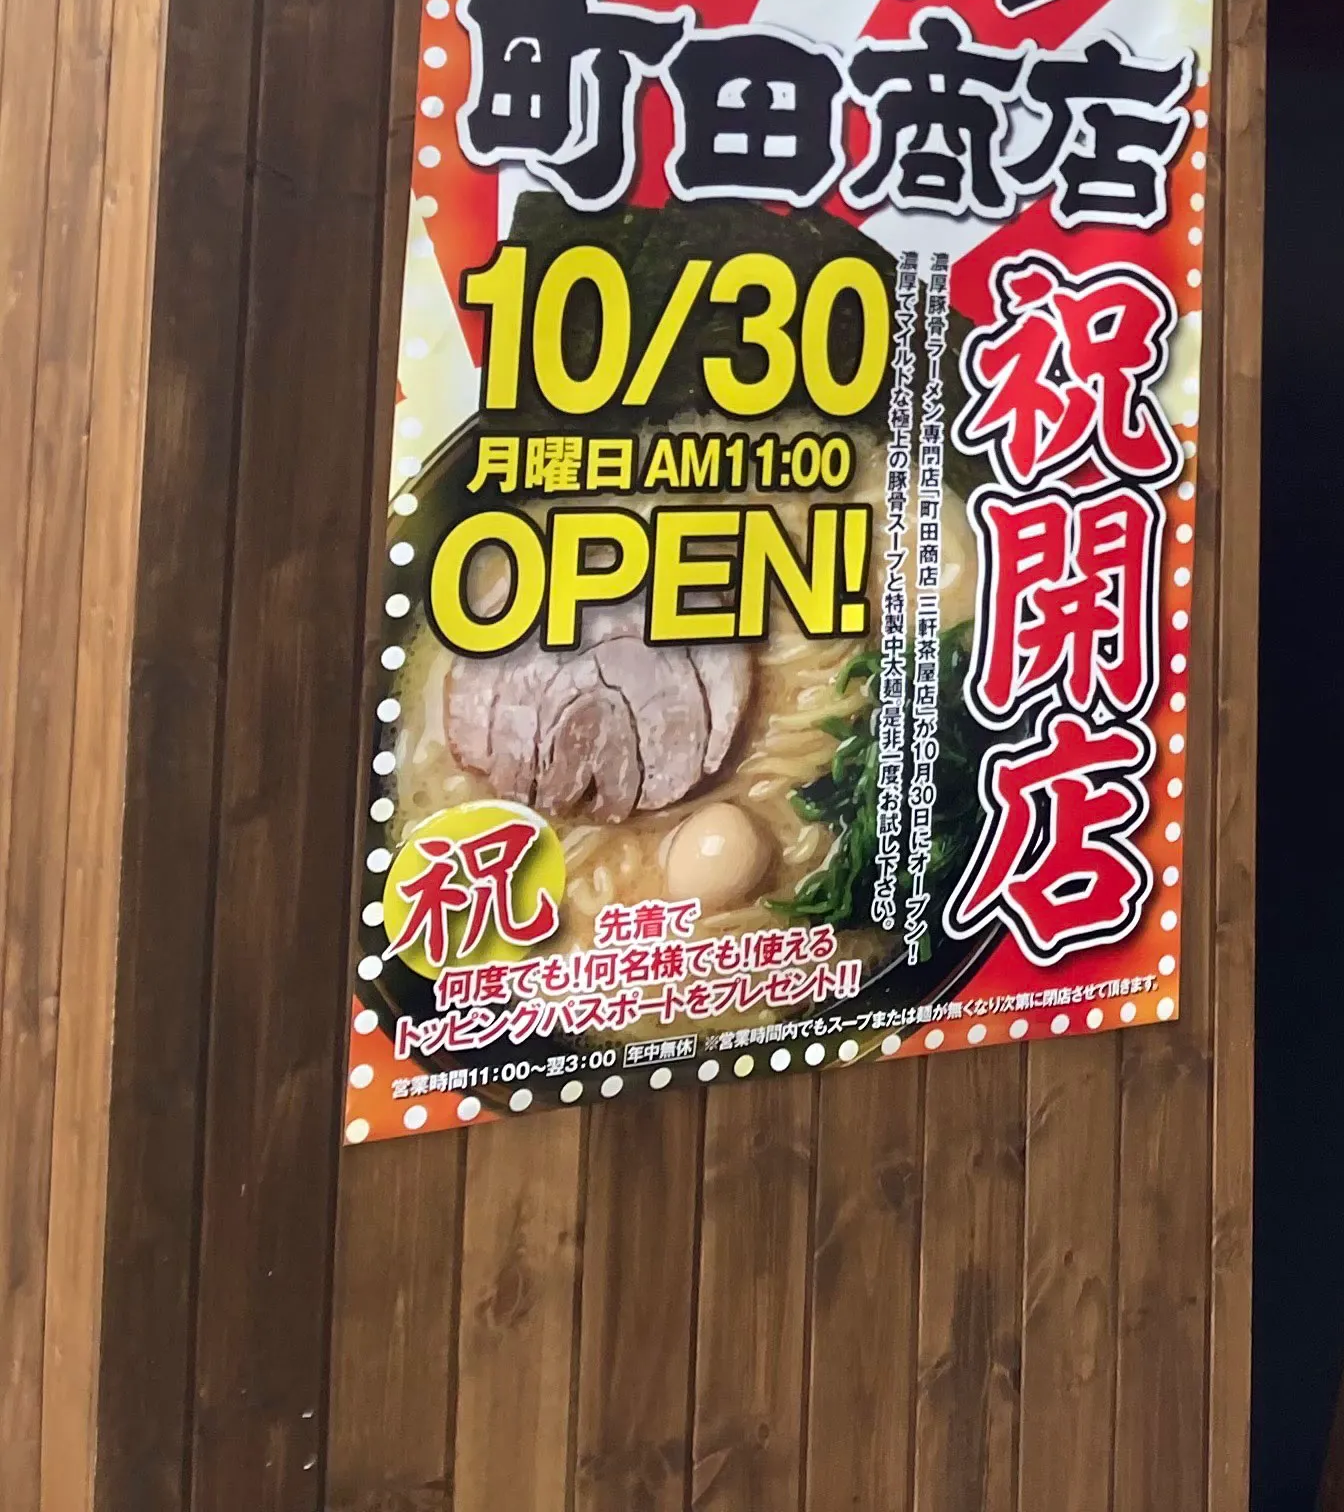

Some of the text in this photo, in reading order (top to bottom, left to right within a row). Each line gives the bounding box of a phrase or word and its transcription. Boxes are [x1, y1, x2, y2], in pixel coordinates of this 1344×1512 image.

[464, 245, 888, 418] 10/30
[467, 436, 851, 493] 月曜日 AM11:00
[430, 507, 868, 653] OPEN!
[955, 265, 1176, 950] 祝開店
[384, 823, 556, 964] 祝
[598, 899, 699, 945] 先着で
[627, 1039, 694, 1065] 年中無休
